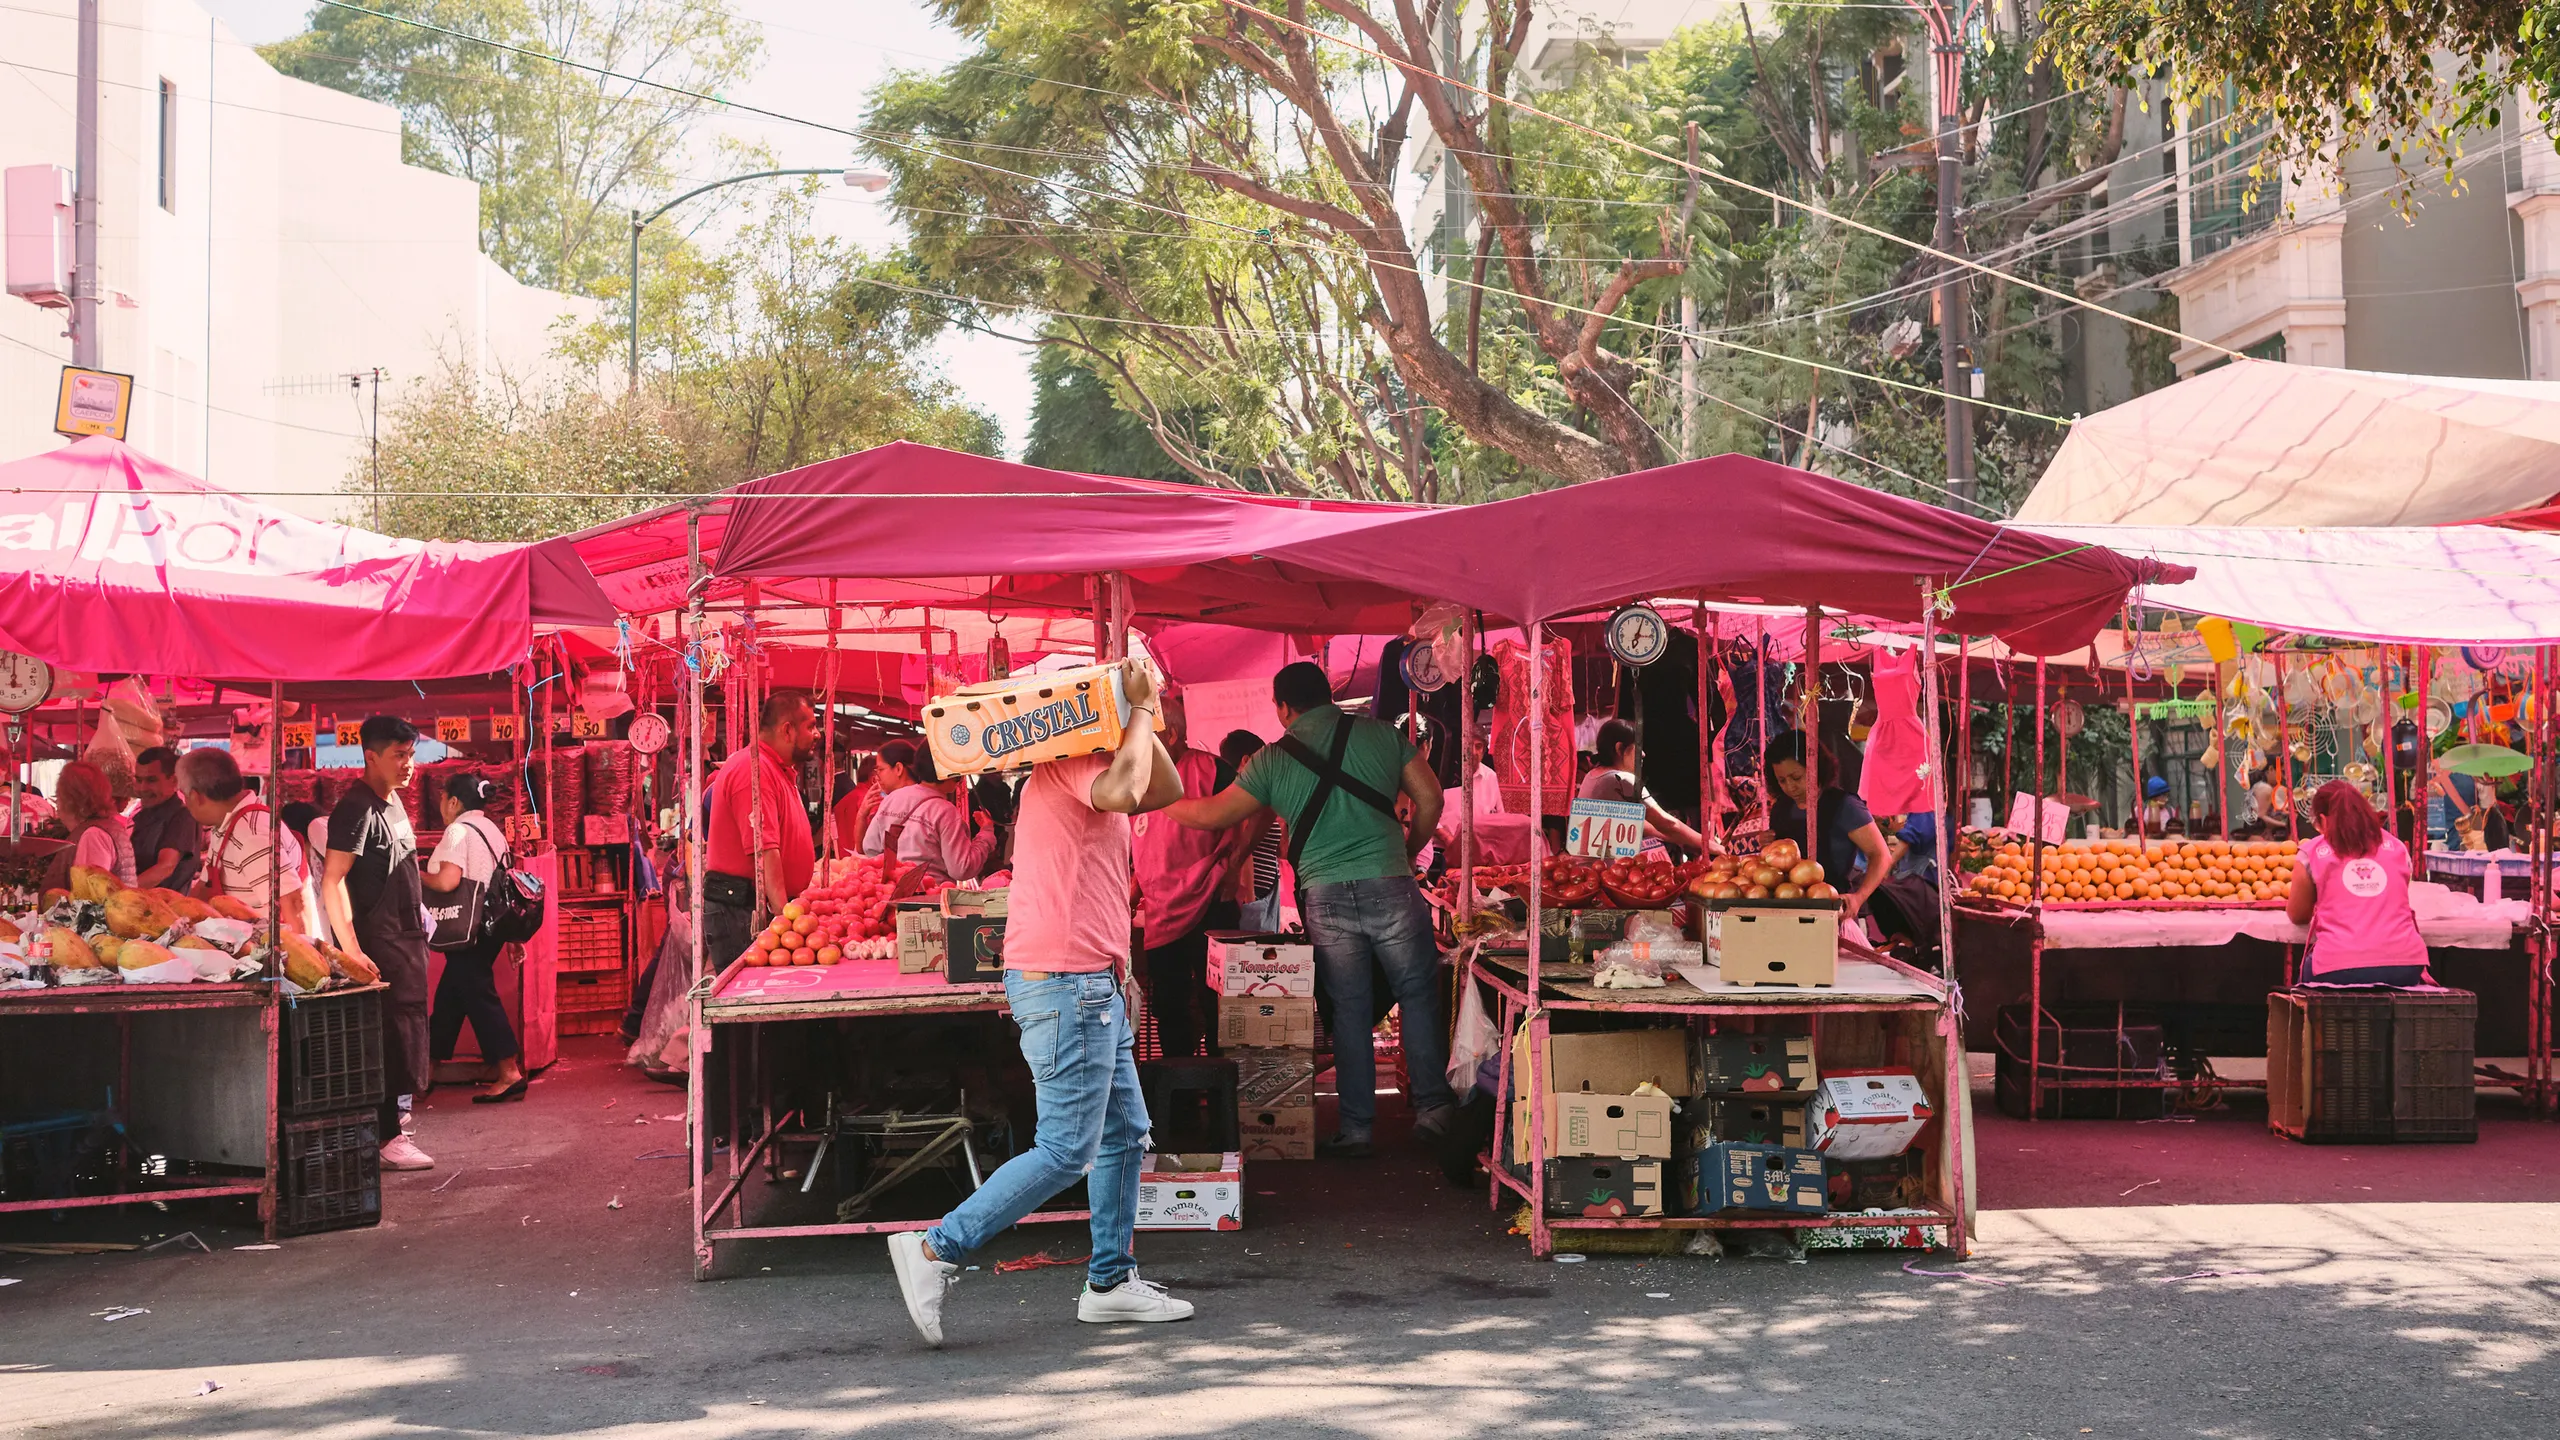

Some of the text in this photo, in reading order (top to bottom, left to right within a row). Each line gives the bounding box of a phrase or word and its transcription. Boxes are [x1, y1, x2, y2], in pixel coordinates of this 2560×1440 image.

[496, 724, 512, 739] 40
[981, 692, 1099, 758] CRYSTAL
[285, 732, 305, 747] 35
[340, 731, 359, 746] 35
[442, 728, 459, 741] 40
[1616, 847, 1635, 856] KILO
[1239, 960, 1300, 974] Tomatoes
[1163, 1201, 1209, 1217] Tomates
